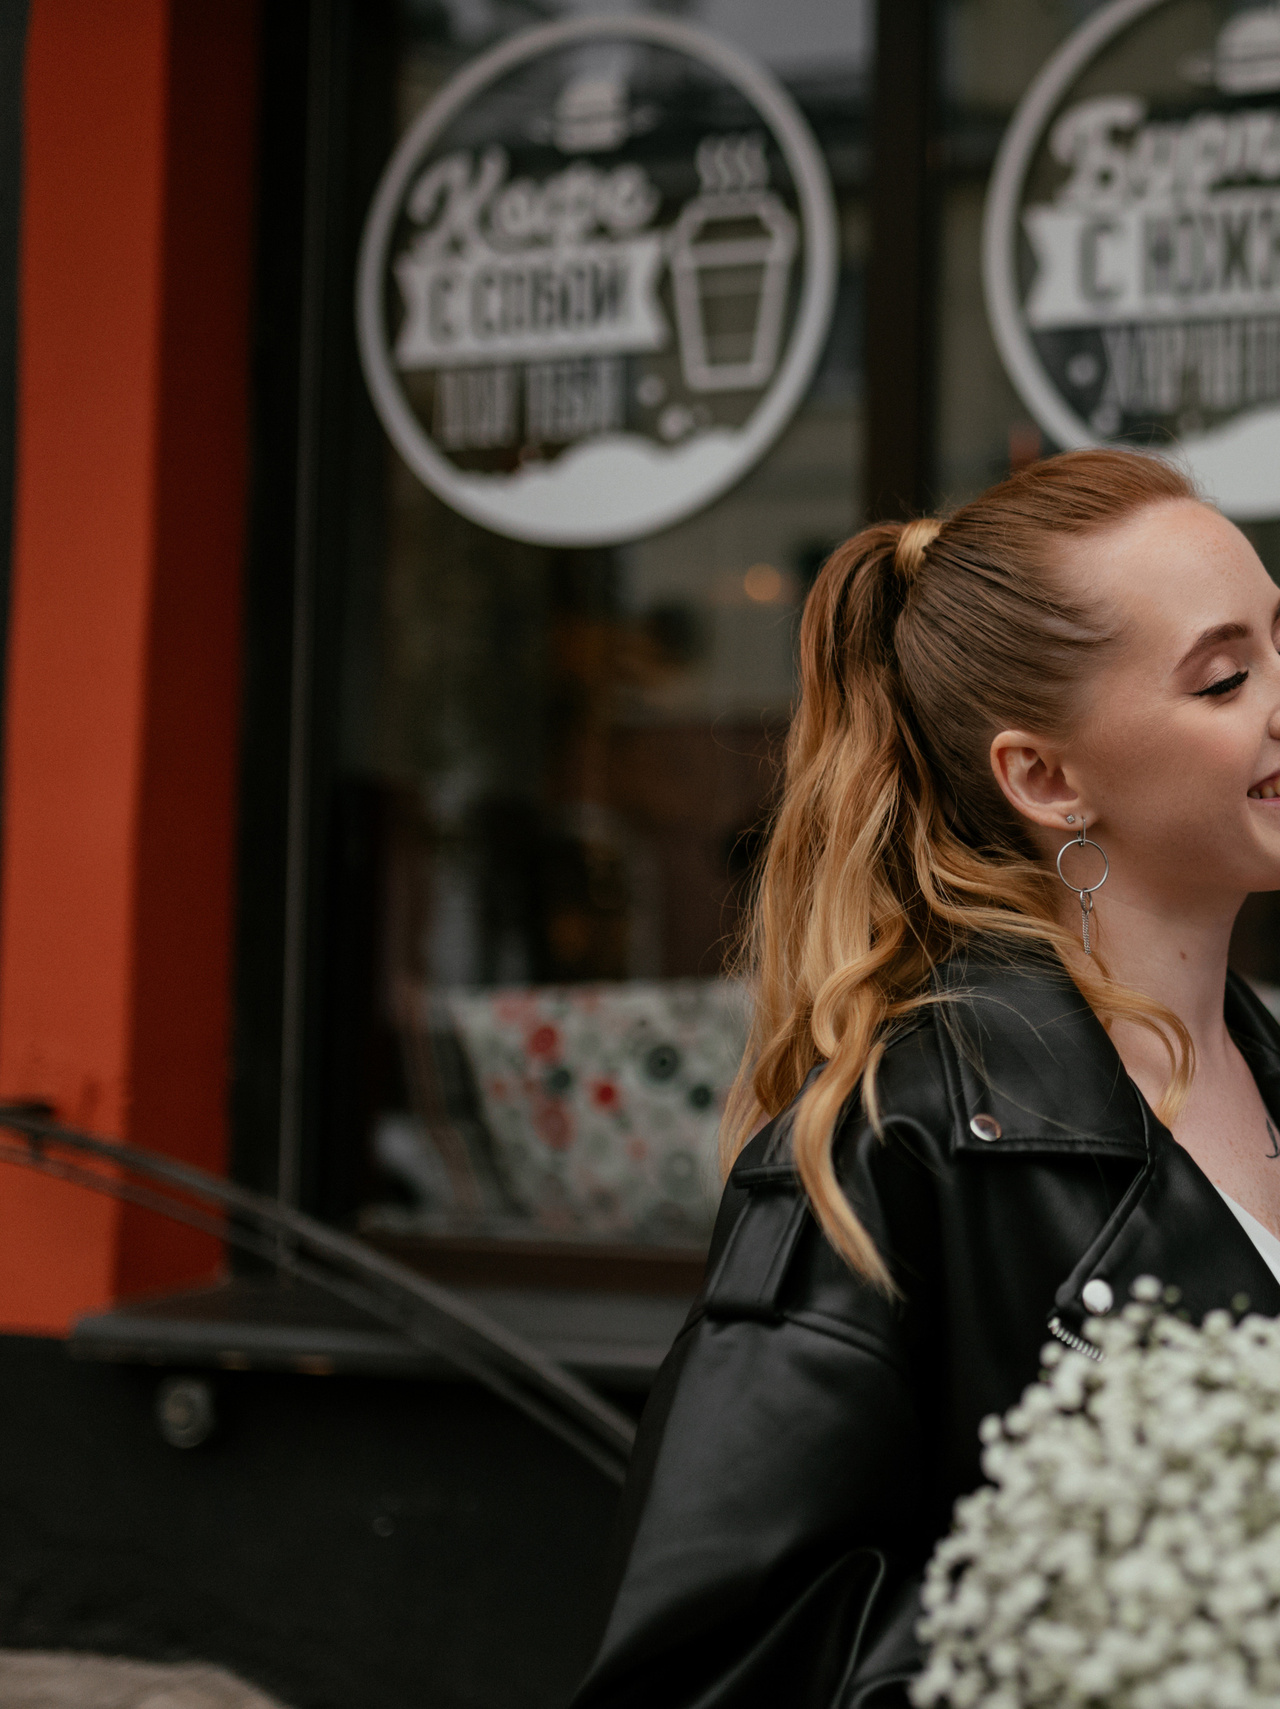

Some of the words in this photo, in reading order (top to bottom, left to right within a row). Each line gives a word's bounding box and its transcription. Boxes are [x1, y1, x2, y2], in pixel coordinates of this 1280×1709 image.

[406, 144, 662, 256] Кофе
[428, 270, 460, 345] С
[469, 257, 632, 343] СОБОЙ
[1080, 220, 1119, 300] С
